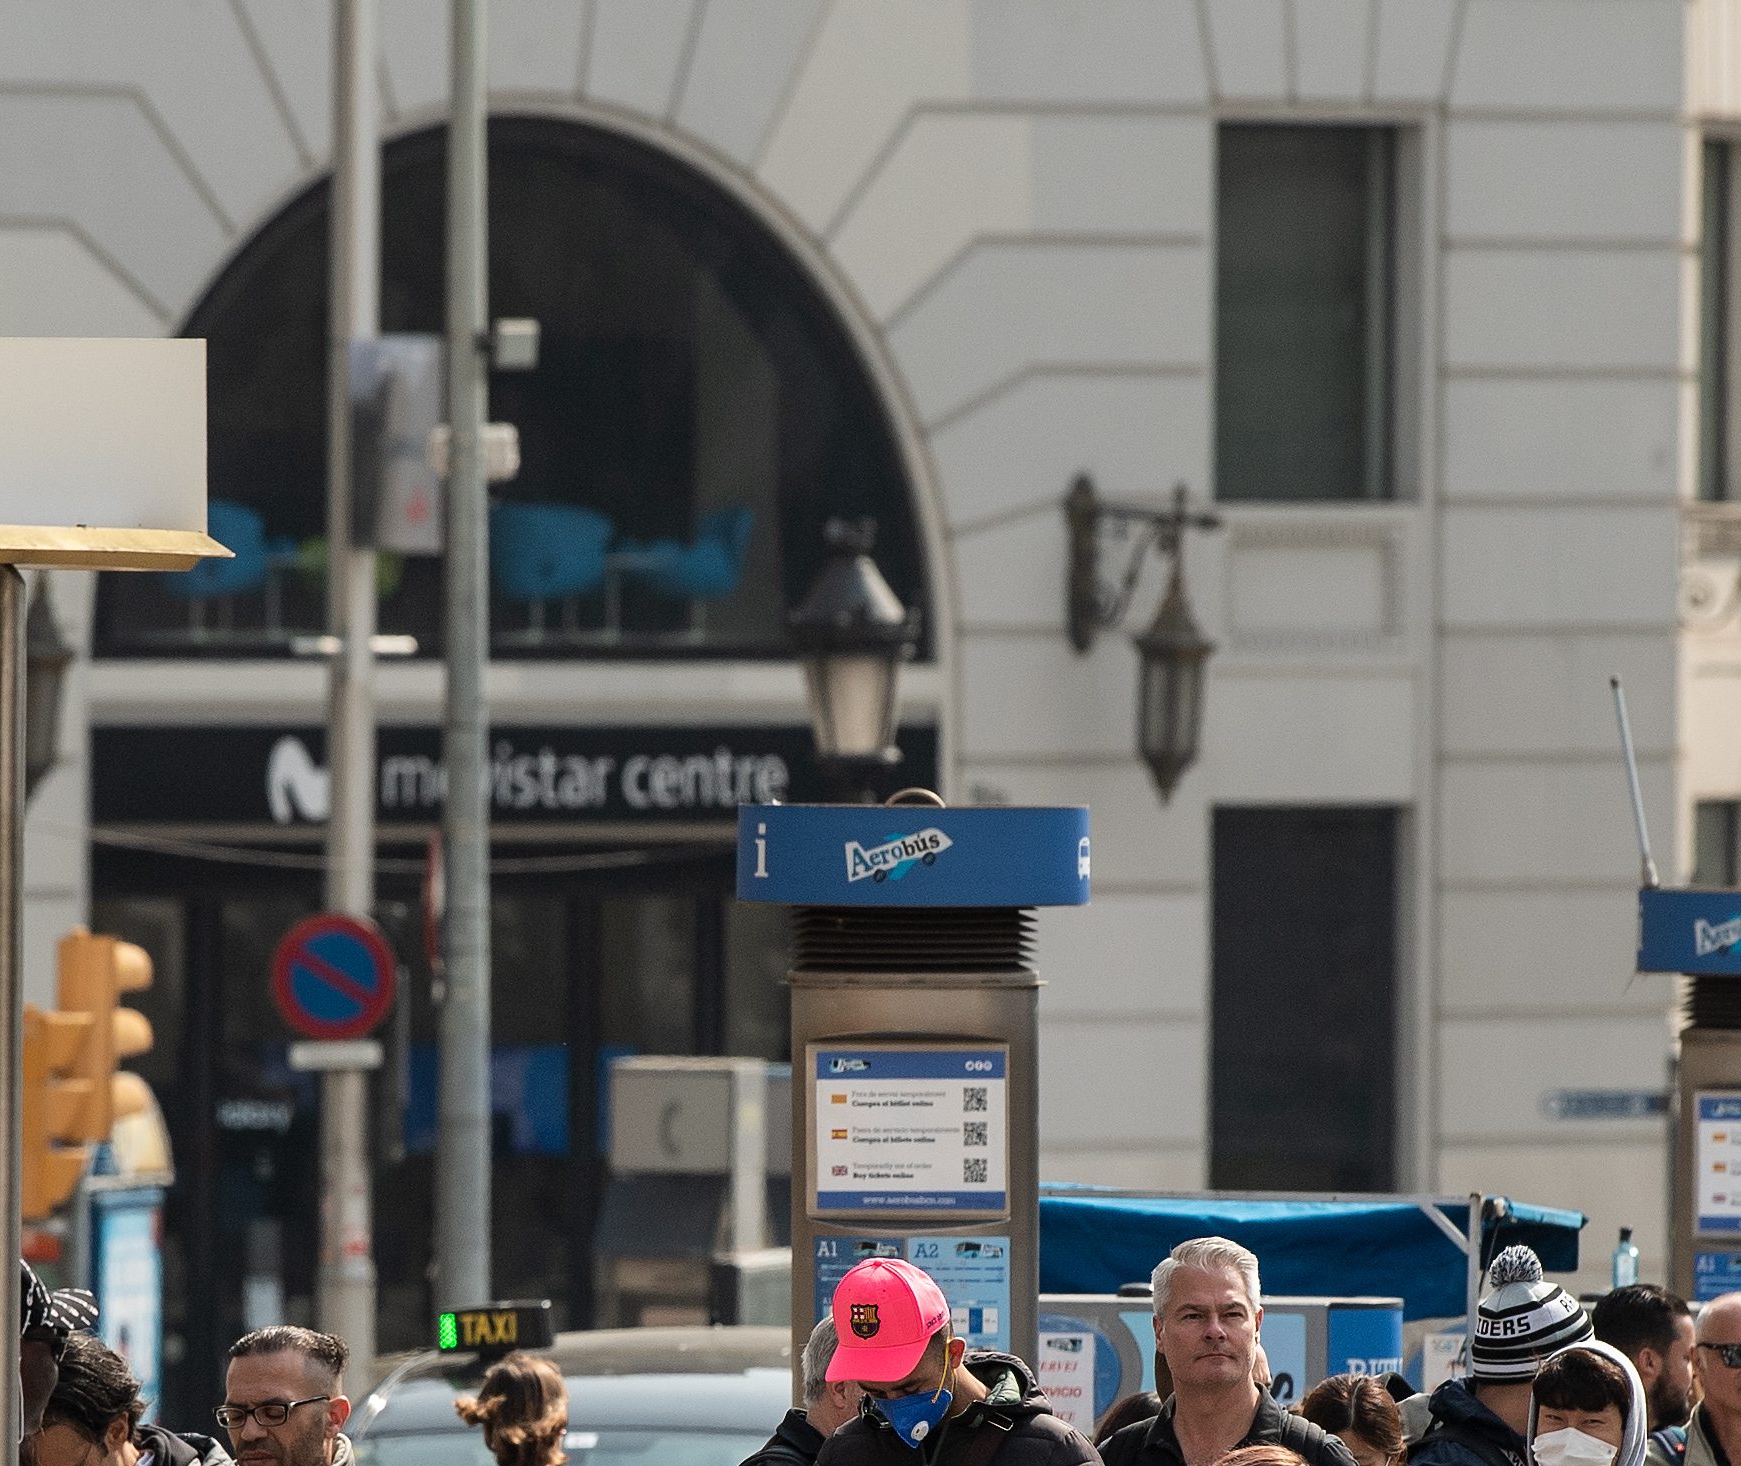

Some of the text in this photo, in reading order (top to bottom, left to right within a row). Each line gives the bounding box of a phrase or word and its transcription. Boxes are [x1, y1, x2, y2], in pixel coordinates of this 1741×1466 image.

[380, 740, 789, 807] moistar centre
[850, 832, 941, 878] Aerobús
[817, 1240, 838, 1258] A1
[913, 1243, 940, 1259] A2
[460, 1310, 518, 1347] TAXI
[1040, 1360, 1079, 1372] ERVEI
[1041, 1386, 1083, 1398] RVICIO
